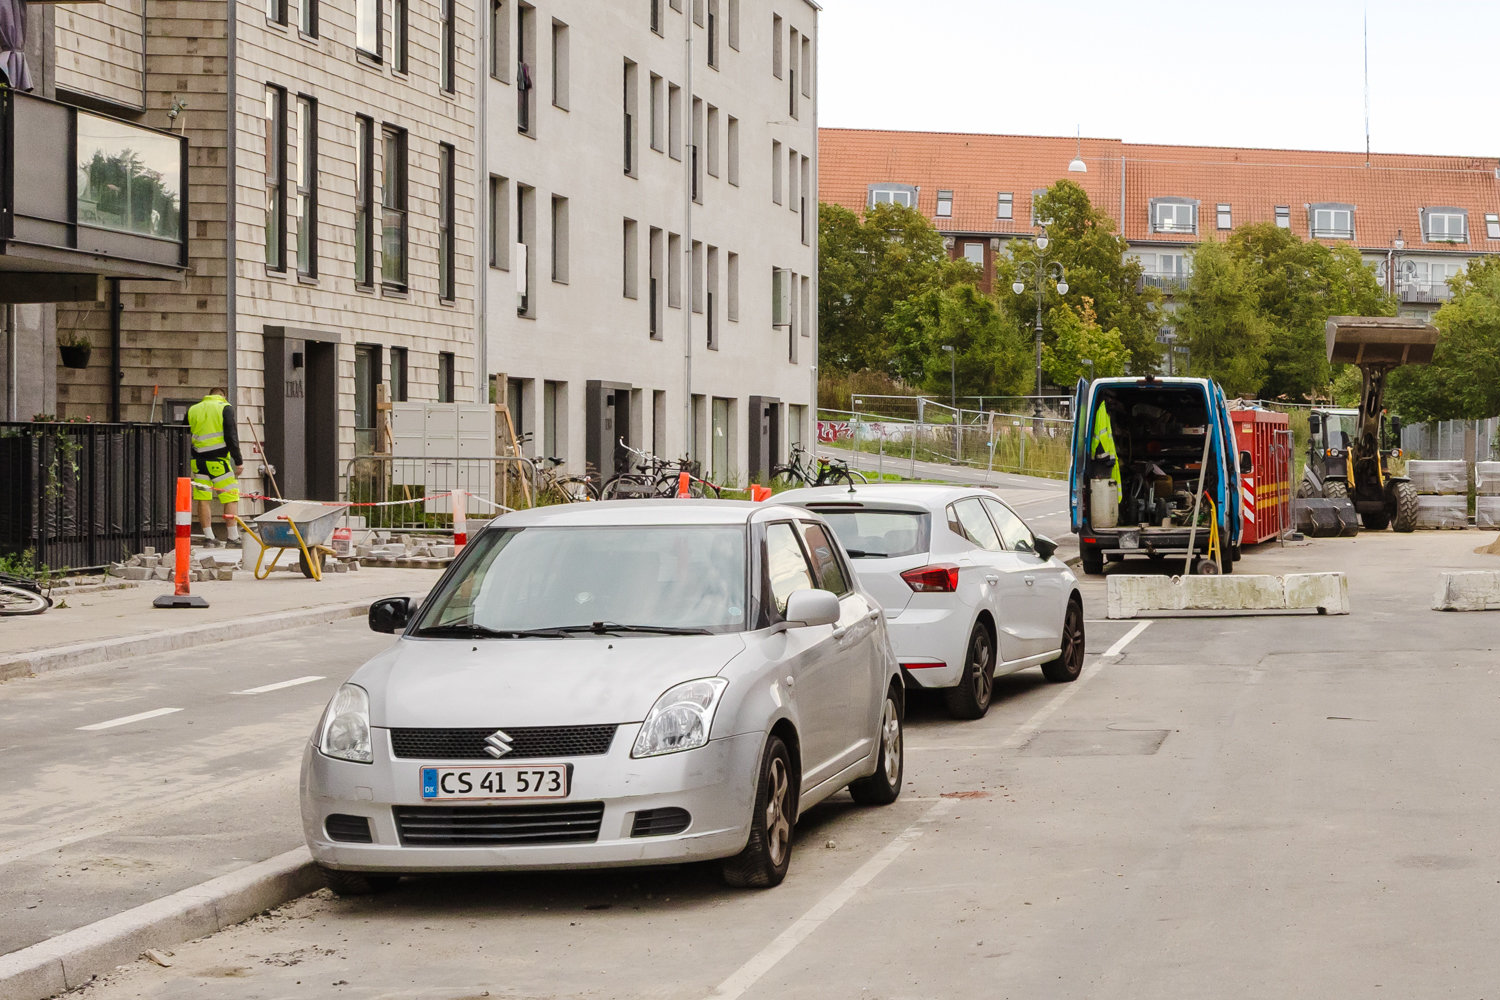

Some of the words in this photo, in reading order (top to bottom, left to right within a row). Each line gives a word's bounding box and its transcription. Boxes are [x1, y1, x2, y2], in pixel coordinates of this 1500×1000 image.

[440, 772, 473, 794] CS
[479, 771, 507, 793] 41
[516, 770, 561, 793] 573
